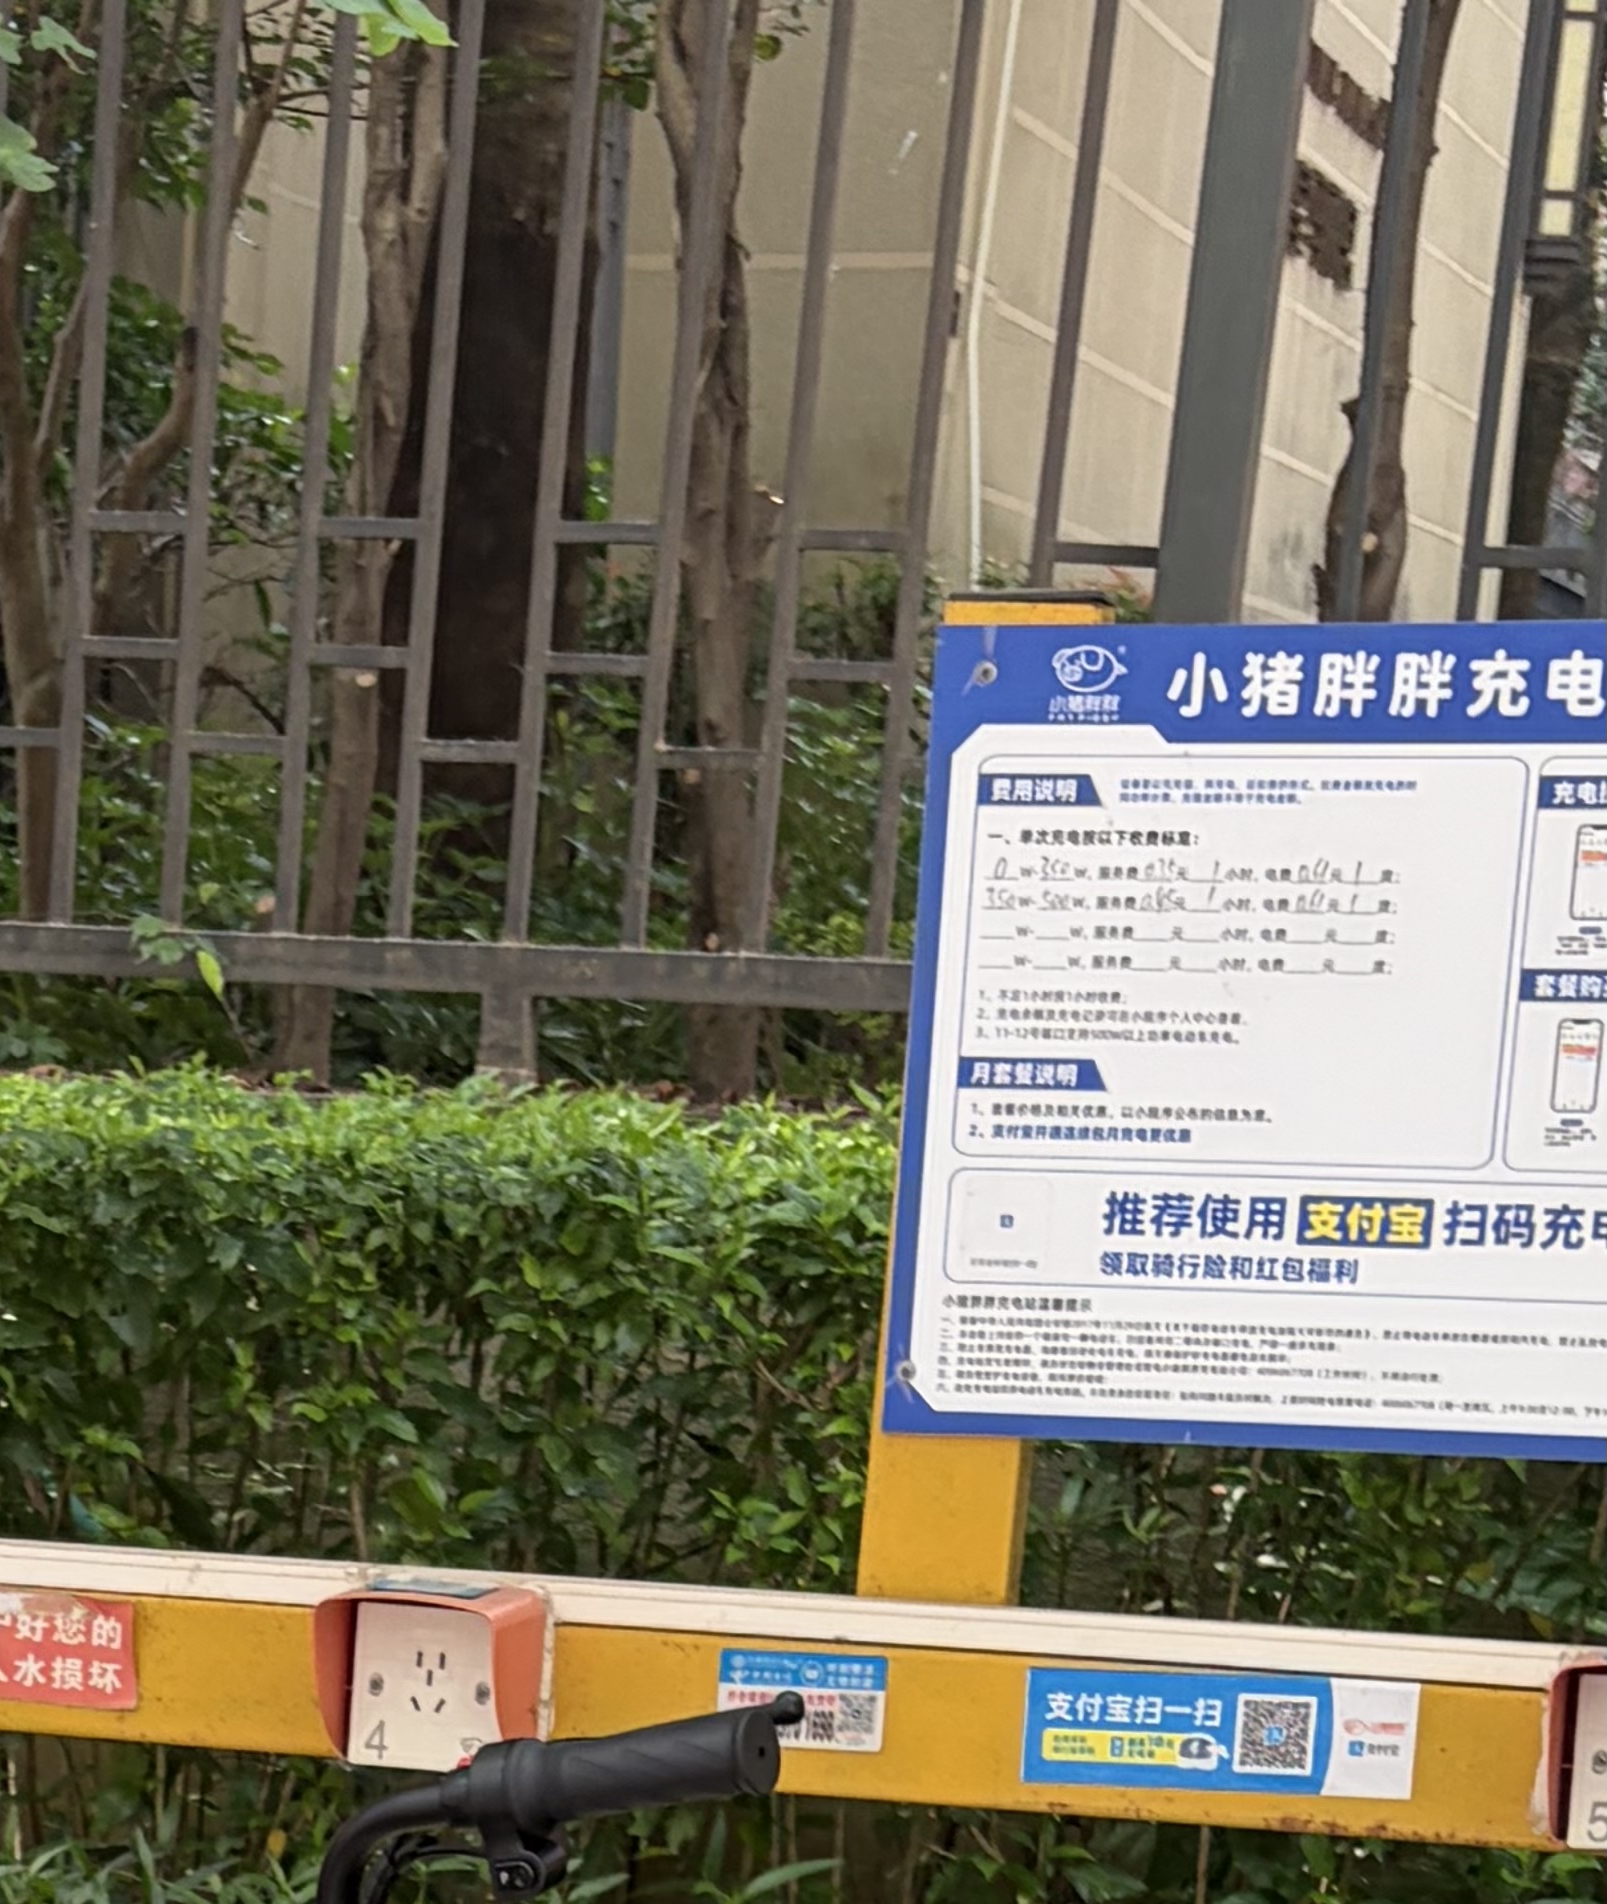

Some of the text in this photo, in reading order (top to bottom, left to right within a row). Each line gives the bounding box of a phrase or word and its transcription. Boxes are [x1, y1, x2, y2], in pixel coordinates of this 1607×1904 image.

[1167, 649, 1606, 718] 小猪胖胖充电
[991, 778, 1077, 803] 费用说明
[1535, 974, 1607, 998] 套餐购
[970, 1061, 1079, 1087] 月套餐说明
[1102, 1191, 1288, 1241] 推荐使用
[1304, 1202, 1427, 1244] 支付宝
[1099, 1250, 1359, 1284] 领取骑行险和红包福利
[1045, 1692, 1223, 1727] 支付宝扫一扫
[364, 1720, 389, 1760] 4
[1587, 1801, 1607, 1842] 5
